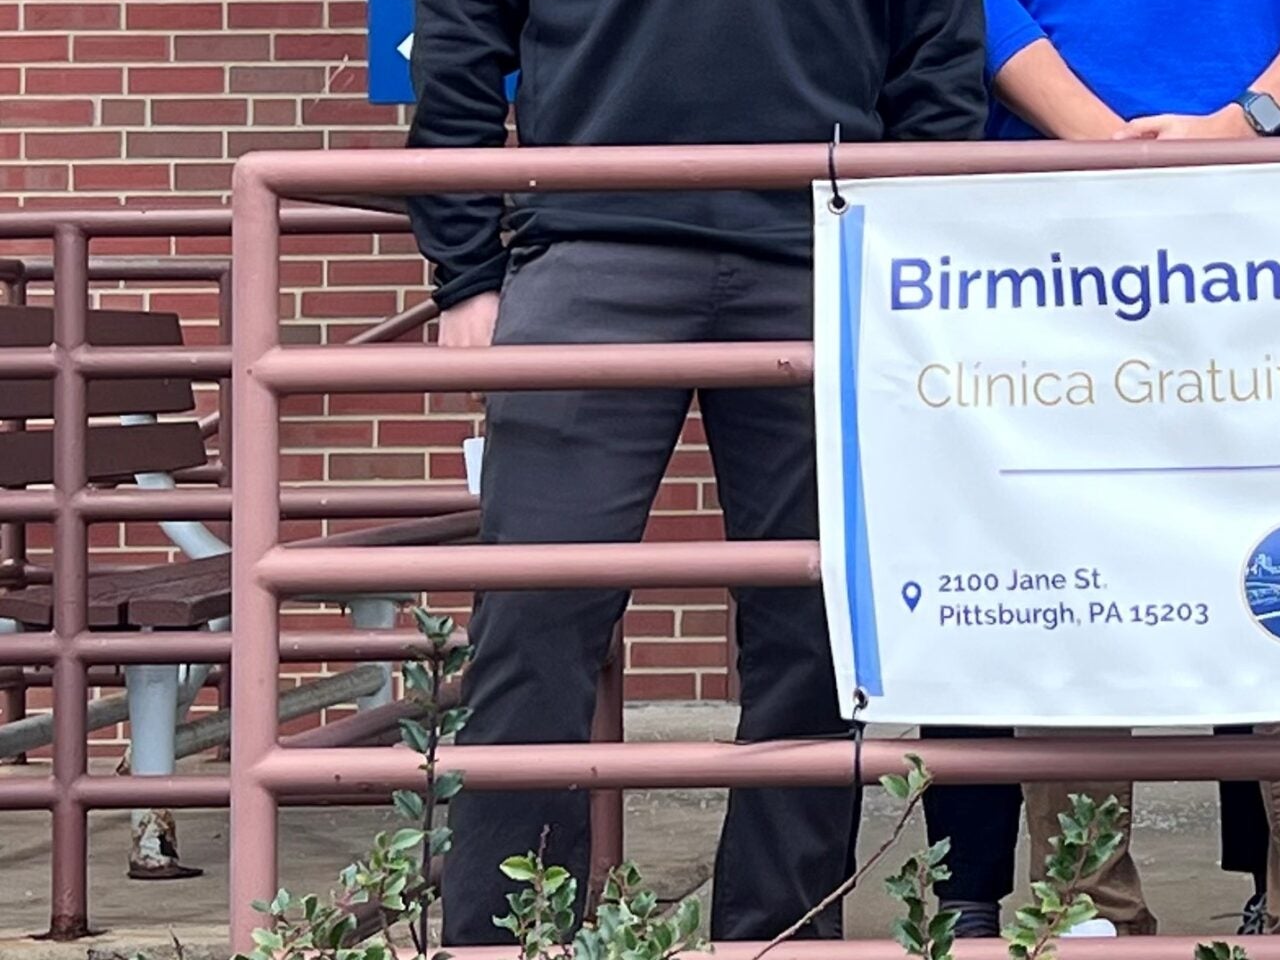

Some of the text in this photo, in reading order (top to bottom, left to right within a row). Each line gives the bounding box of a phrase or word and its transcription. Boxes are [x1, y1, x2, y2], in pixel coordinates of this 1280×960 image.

[917, 361, 1095, 408] Clínica
[938, 568, 1108, 593] 2100 Jane St.
[939, 602, 1209, 630] Pittsburgh, PA 15203
